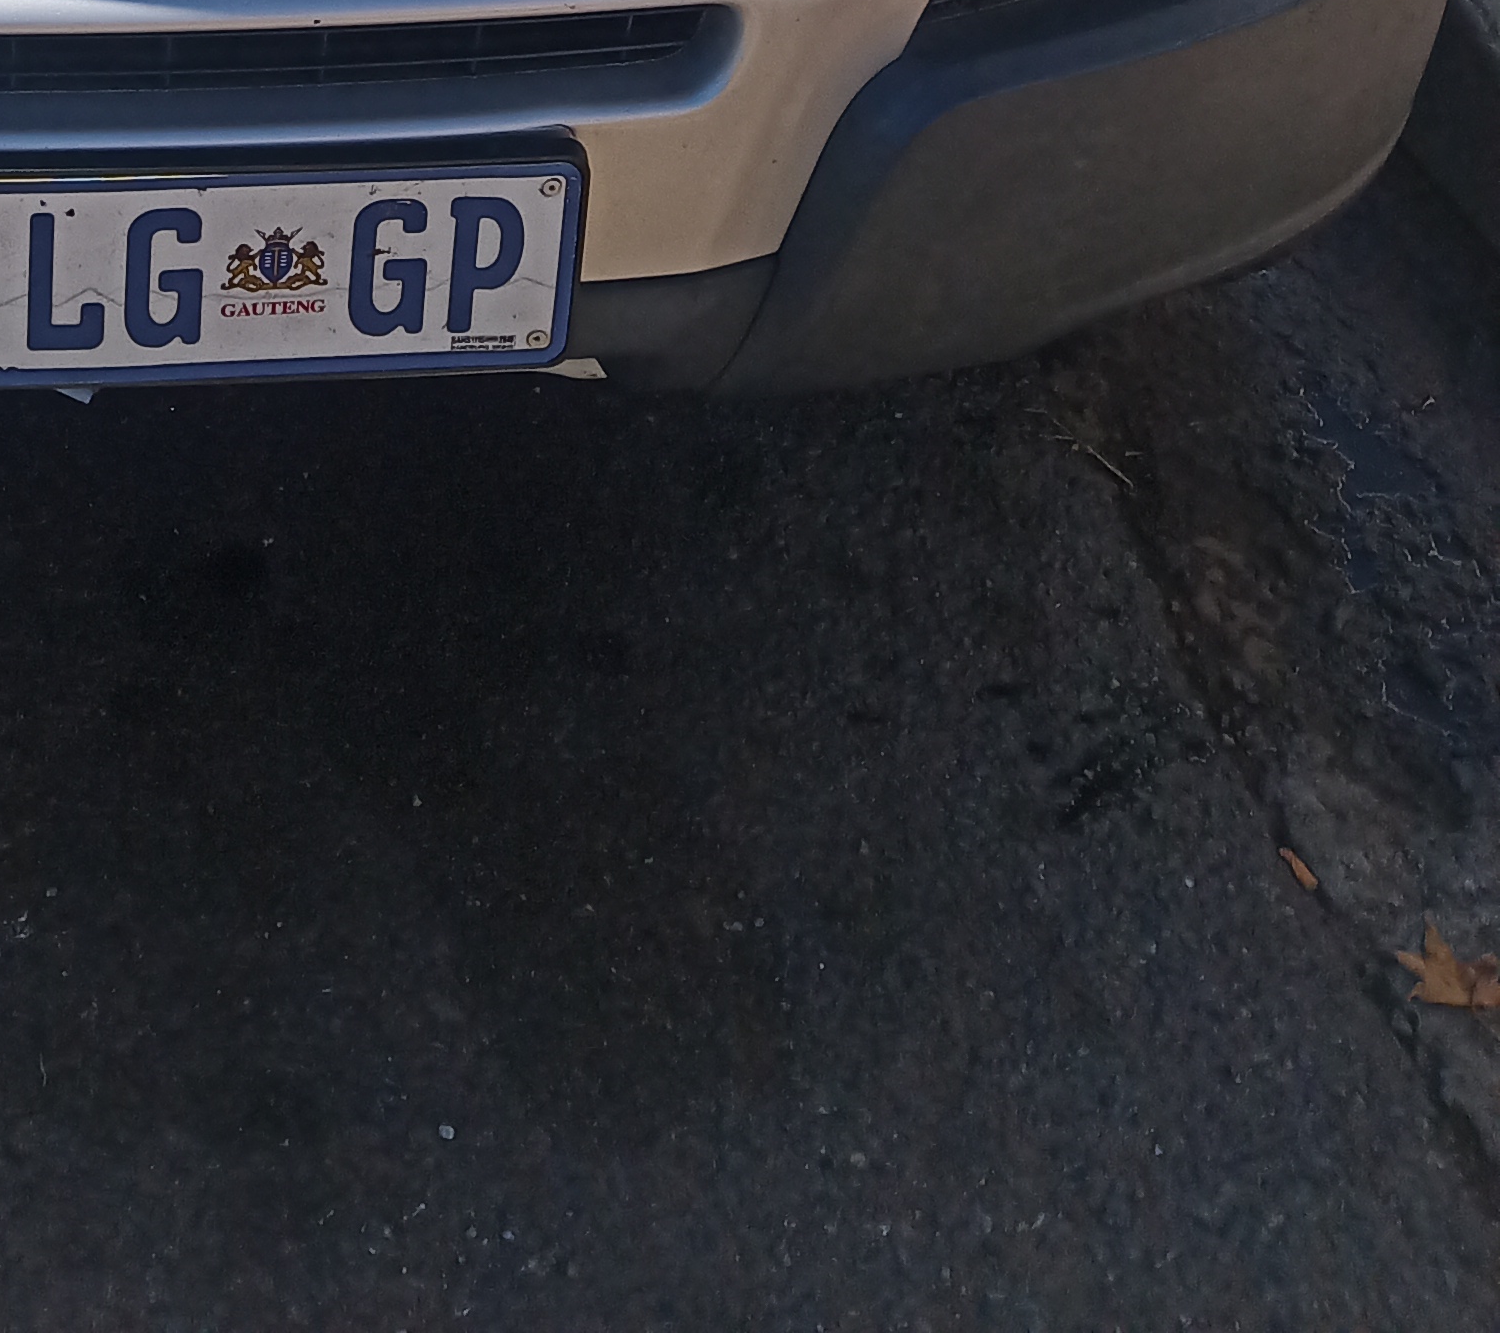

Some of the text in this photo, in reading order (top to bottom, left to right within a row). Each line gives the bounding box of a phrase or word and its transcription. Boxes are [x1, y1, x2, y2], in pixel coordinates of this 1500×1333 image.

[26, 205, 206, 352] LG
[346, 195, 528, 336] GP
[220, 299, 327, 318] GAUTENG
